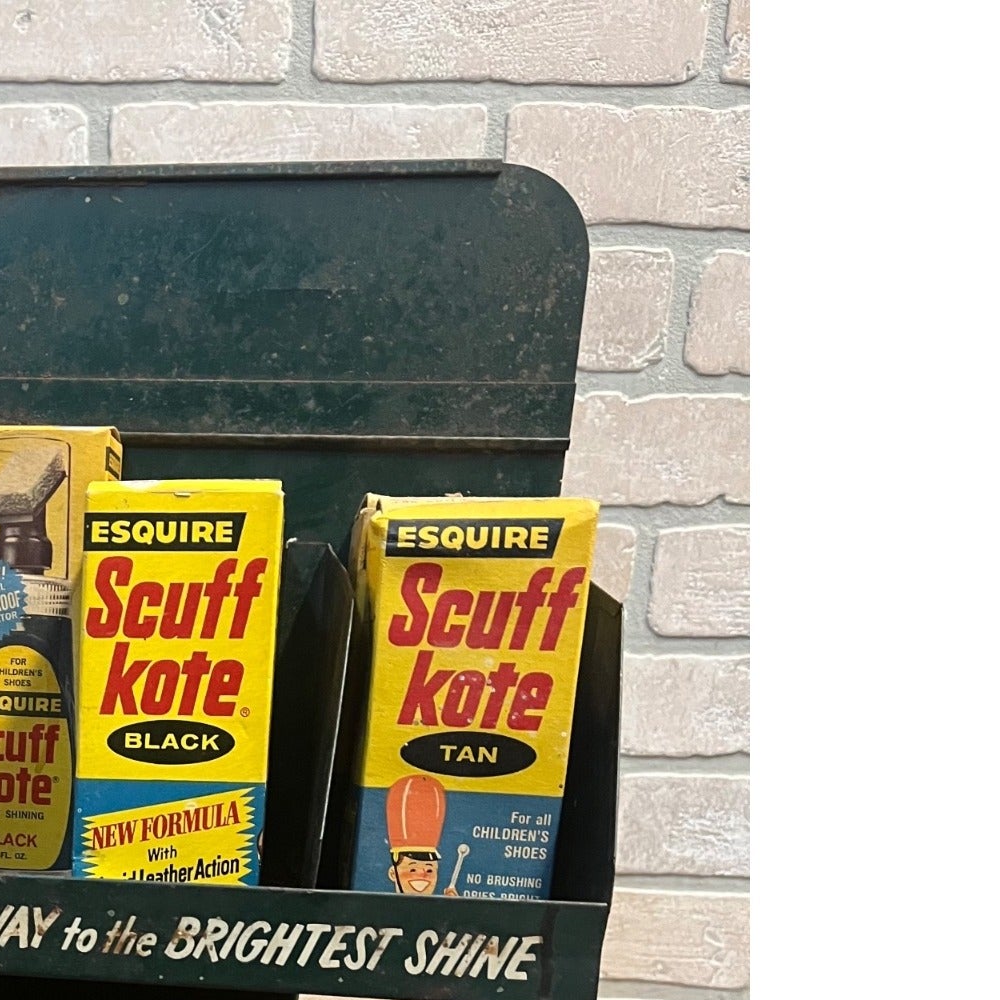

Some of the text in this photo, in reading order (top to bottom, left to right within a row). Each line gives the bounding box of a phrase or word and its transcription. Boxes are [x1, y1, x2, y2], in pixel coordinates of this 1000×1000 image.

[91, 520, 233, 545] ESQUIRE
[396, 525, 549, 550] ESQUIRE
[86, 555, 268, 639] Scuff
[388, 562, 587, 651] Scuff
[10, 658, 27, 666] FOR
[4, 679, 32, 687] SHOES
[99, 641, 244, 717] kote
[397, 650, 554, 731] kote
[124, 732, 220, 751] BLACK
[439, 744, 498, 764] TAN
[5, 810, 44, 820] SHINING
[511, 812, 552, 827] For all
[91, 800, 241, 851] NEW FORMULA
[472, 825, 549, 843] CHILDREN'S
[148, 845, 177, 862] With
[504, 845, 547, 861] SHOES
[466, 873, 542, 890] NO BRUSHING
[61, 917, 98, 952] to
[101, 914, 157, 957] the
[164, 915, 403, 971] BRIGHTEST
[404, 930, 543, 981] SHINE
